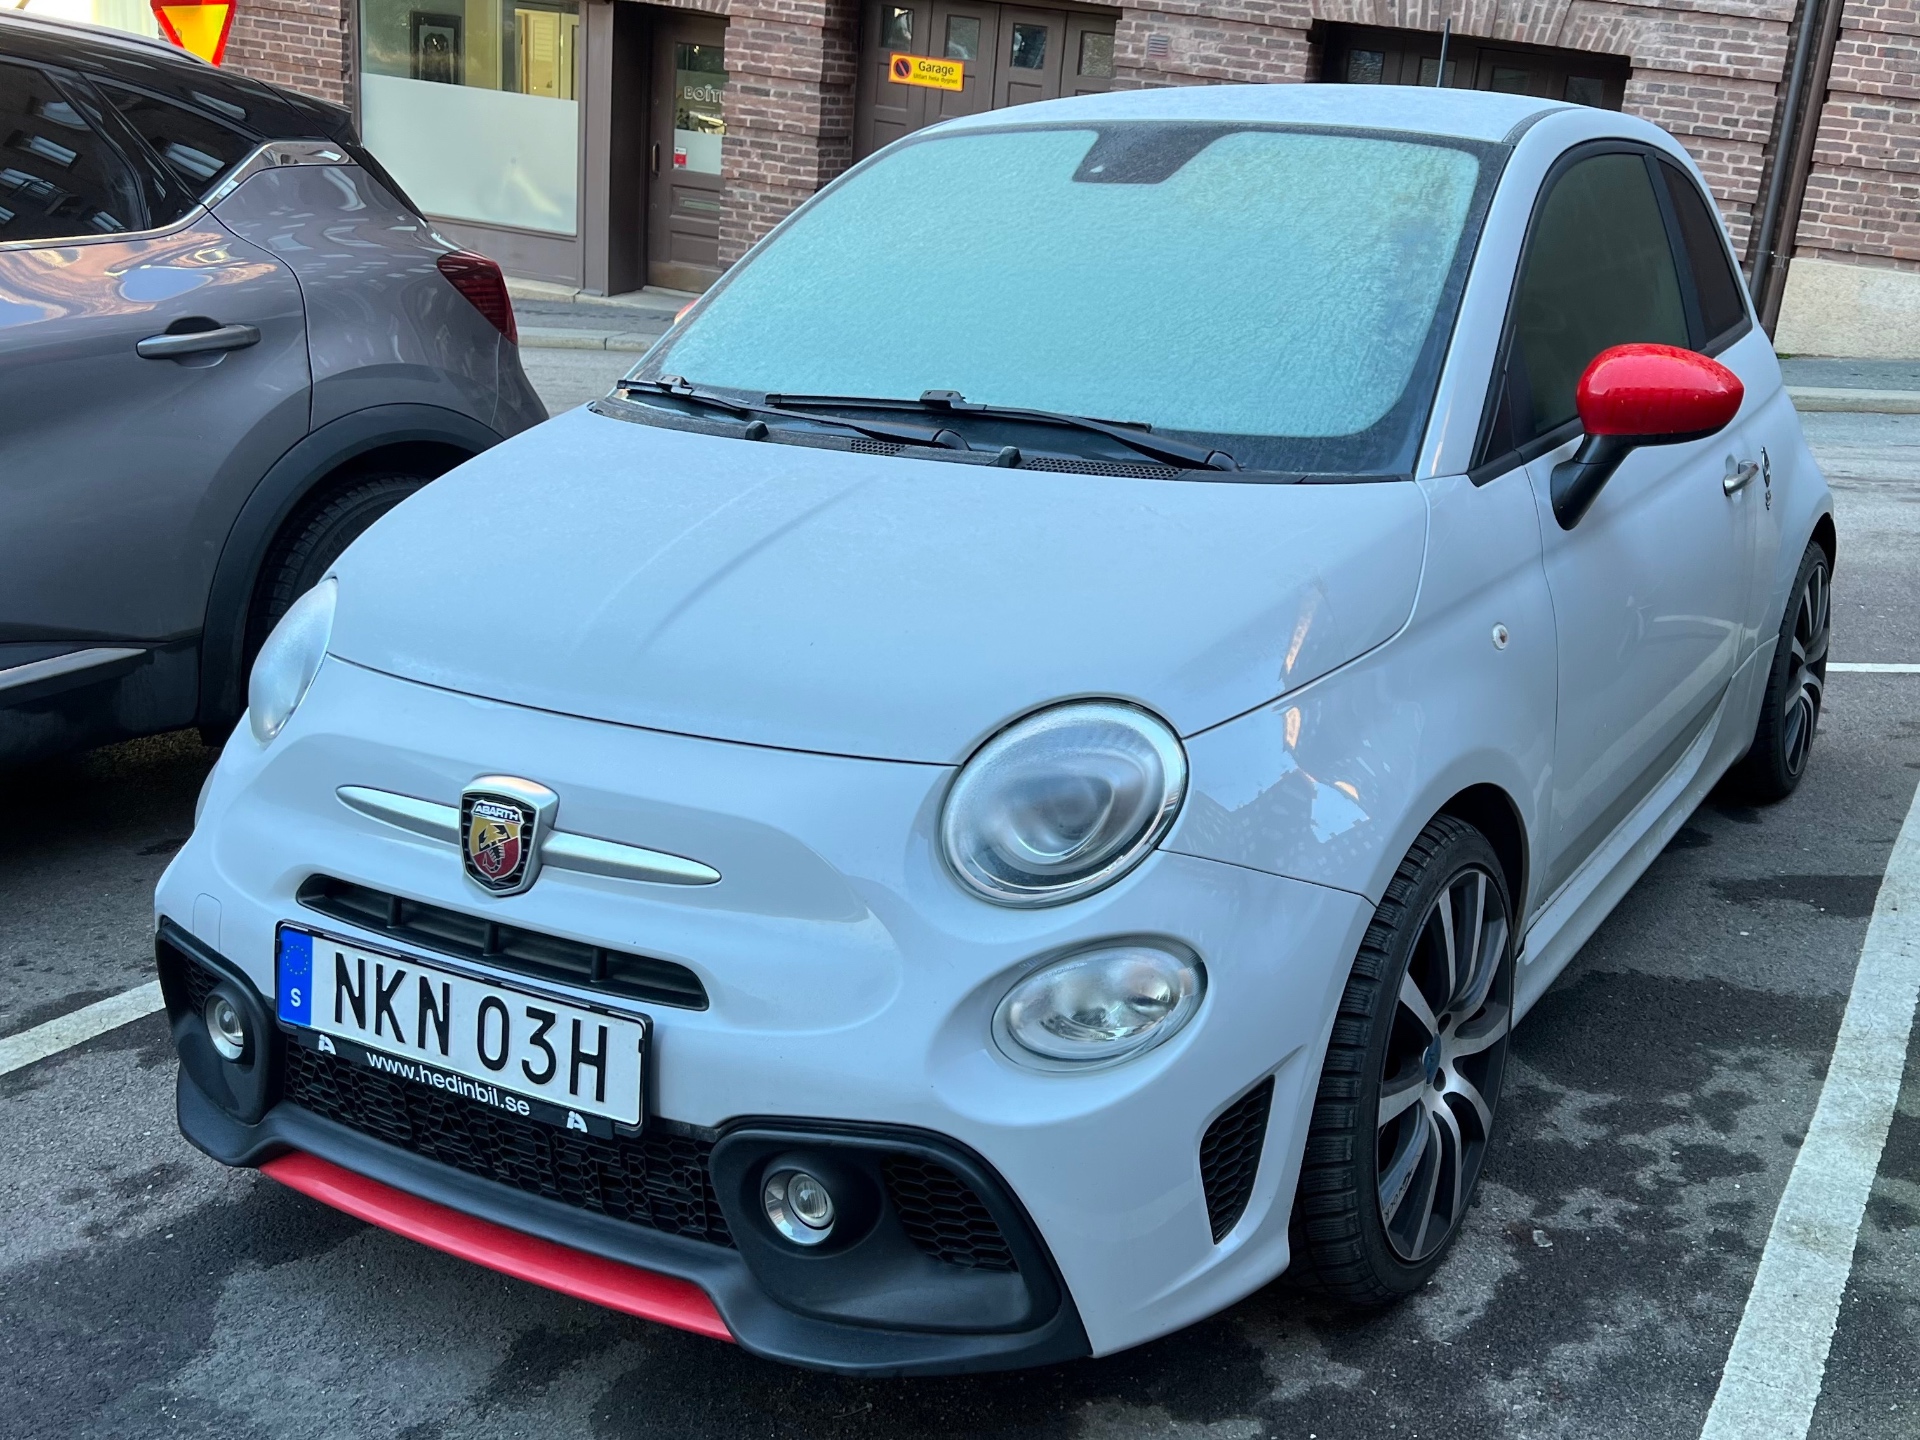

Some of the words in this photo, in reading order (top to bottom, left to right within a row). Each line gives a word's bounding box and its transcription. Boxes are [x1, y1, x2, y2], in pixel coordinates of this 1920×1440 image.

[918, 61, 954, 76] Garage
[475, 804, 518, 820] ABARTH
[289, 987, 302, 1008] S
[334, 951, 451, 1057] NKN
[476, 995, 608, 1103] 03H
[366, 1051, 531, 1117] www.hedinbil.se
